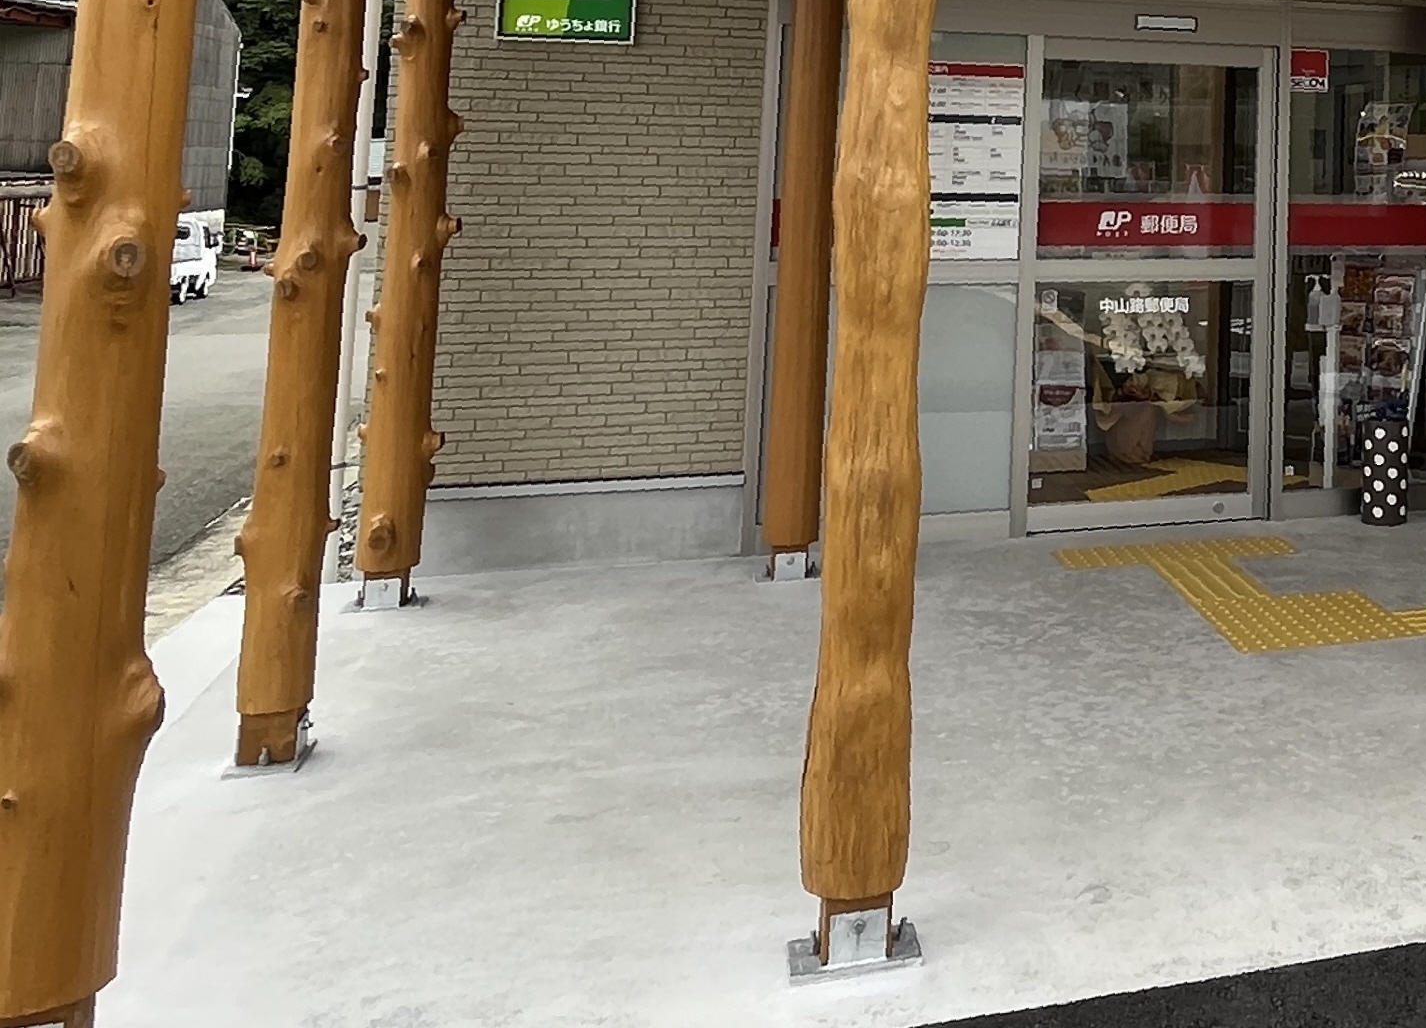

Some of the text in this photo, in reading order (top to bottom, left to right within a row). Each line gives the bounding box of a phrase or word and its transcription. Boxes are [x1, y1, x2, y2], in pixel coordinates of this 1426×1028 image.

[545, 19, 622, 35] ゆうちょ銀行
[1140, 214, 1198, 235] 郵便局
[1099, 296, 1190, 314] 中山路郵便局
